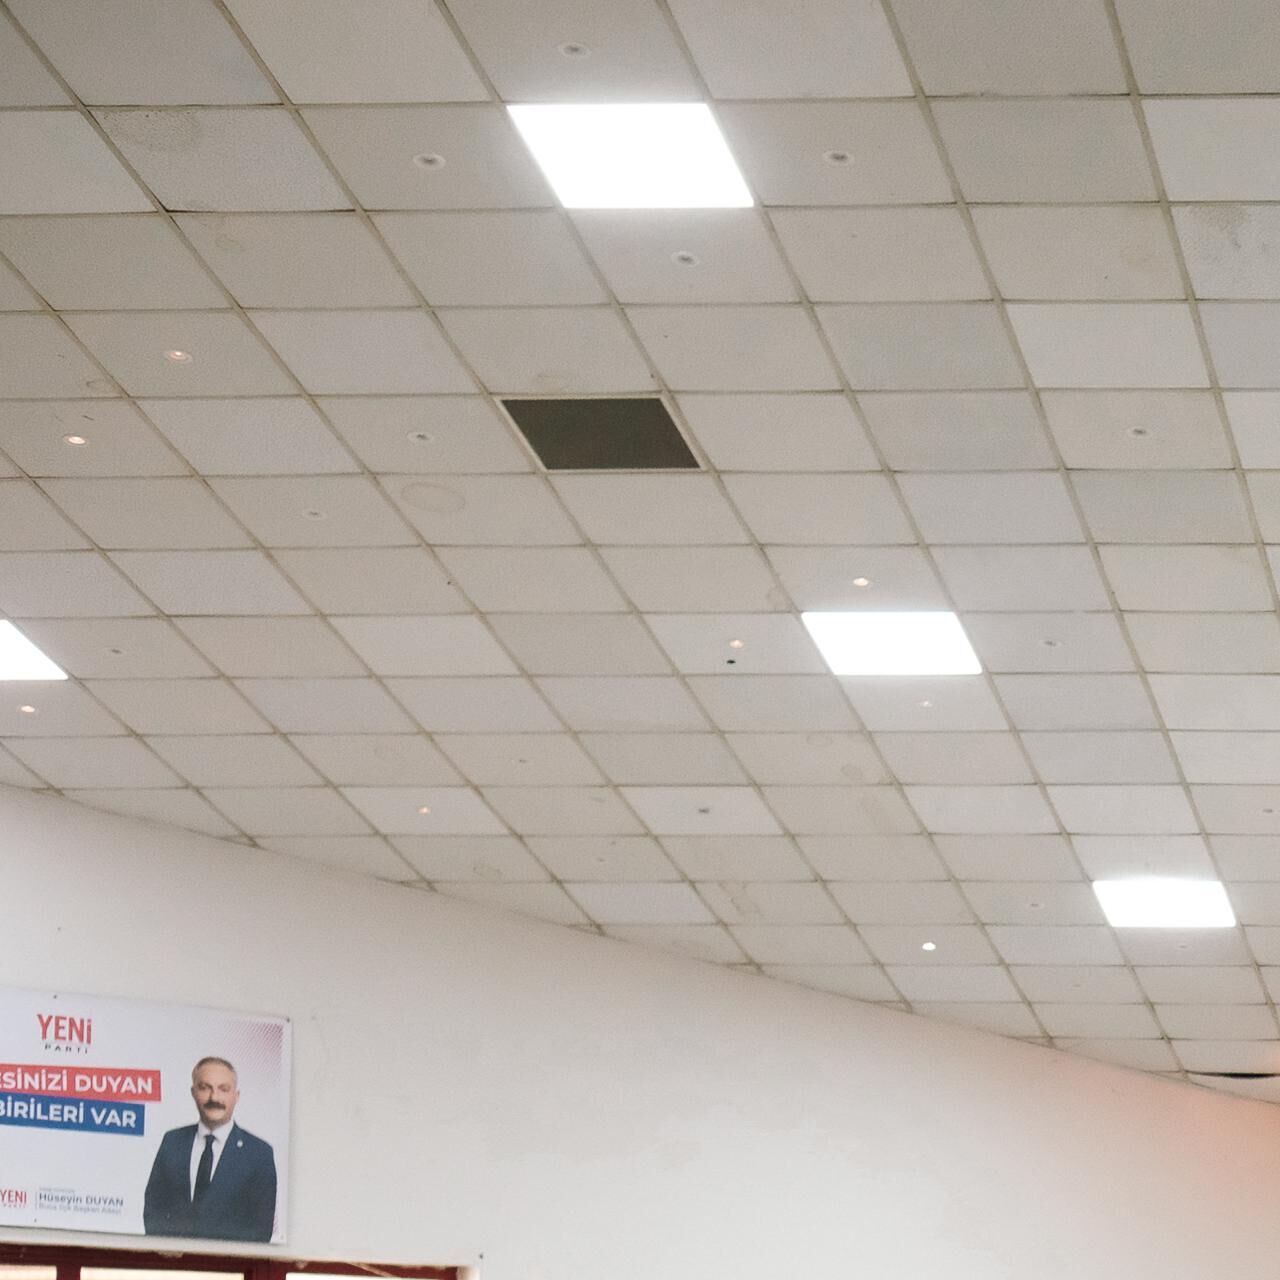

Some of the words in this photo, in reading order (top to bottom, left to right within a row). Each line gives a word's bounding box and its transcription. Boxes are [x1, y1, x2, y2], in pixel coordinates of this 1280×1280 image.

[74, 1073, 153, 1095] DUYAN
[90, 1107, 137, 1129] VAR
[85, 1195, 125, 1208] DUYAN
